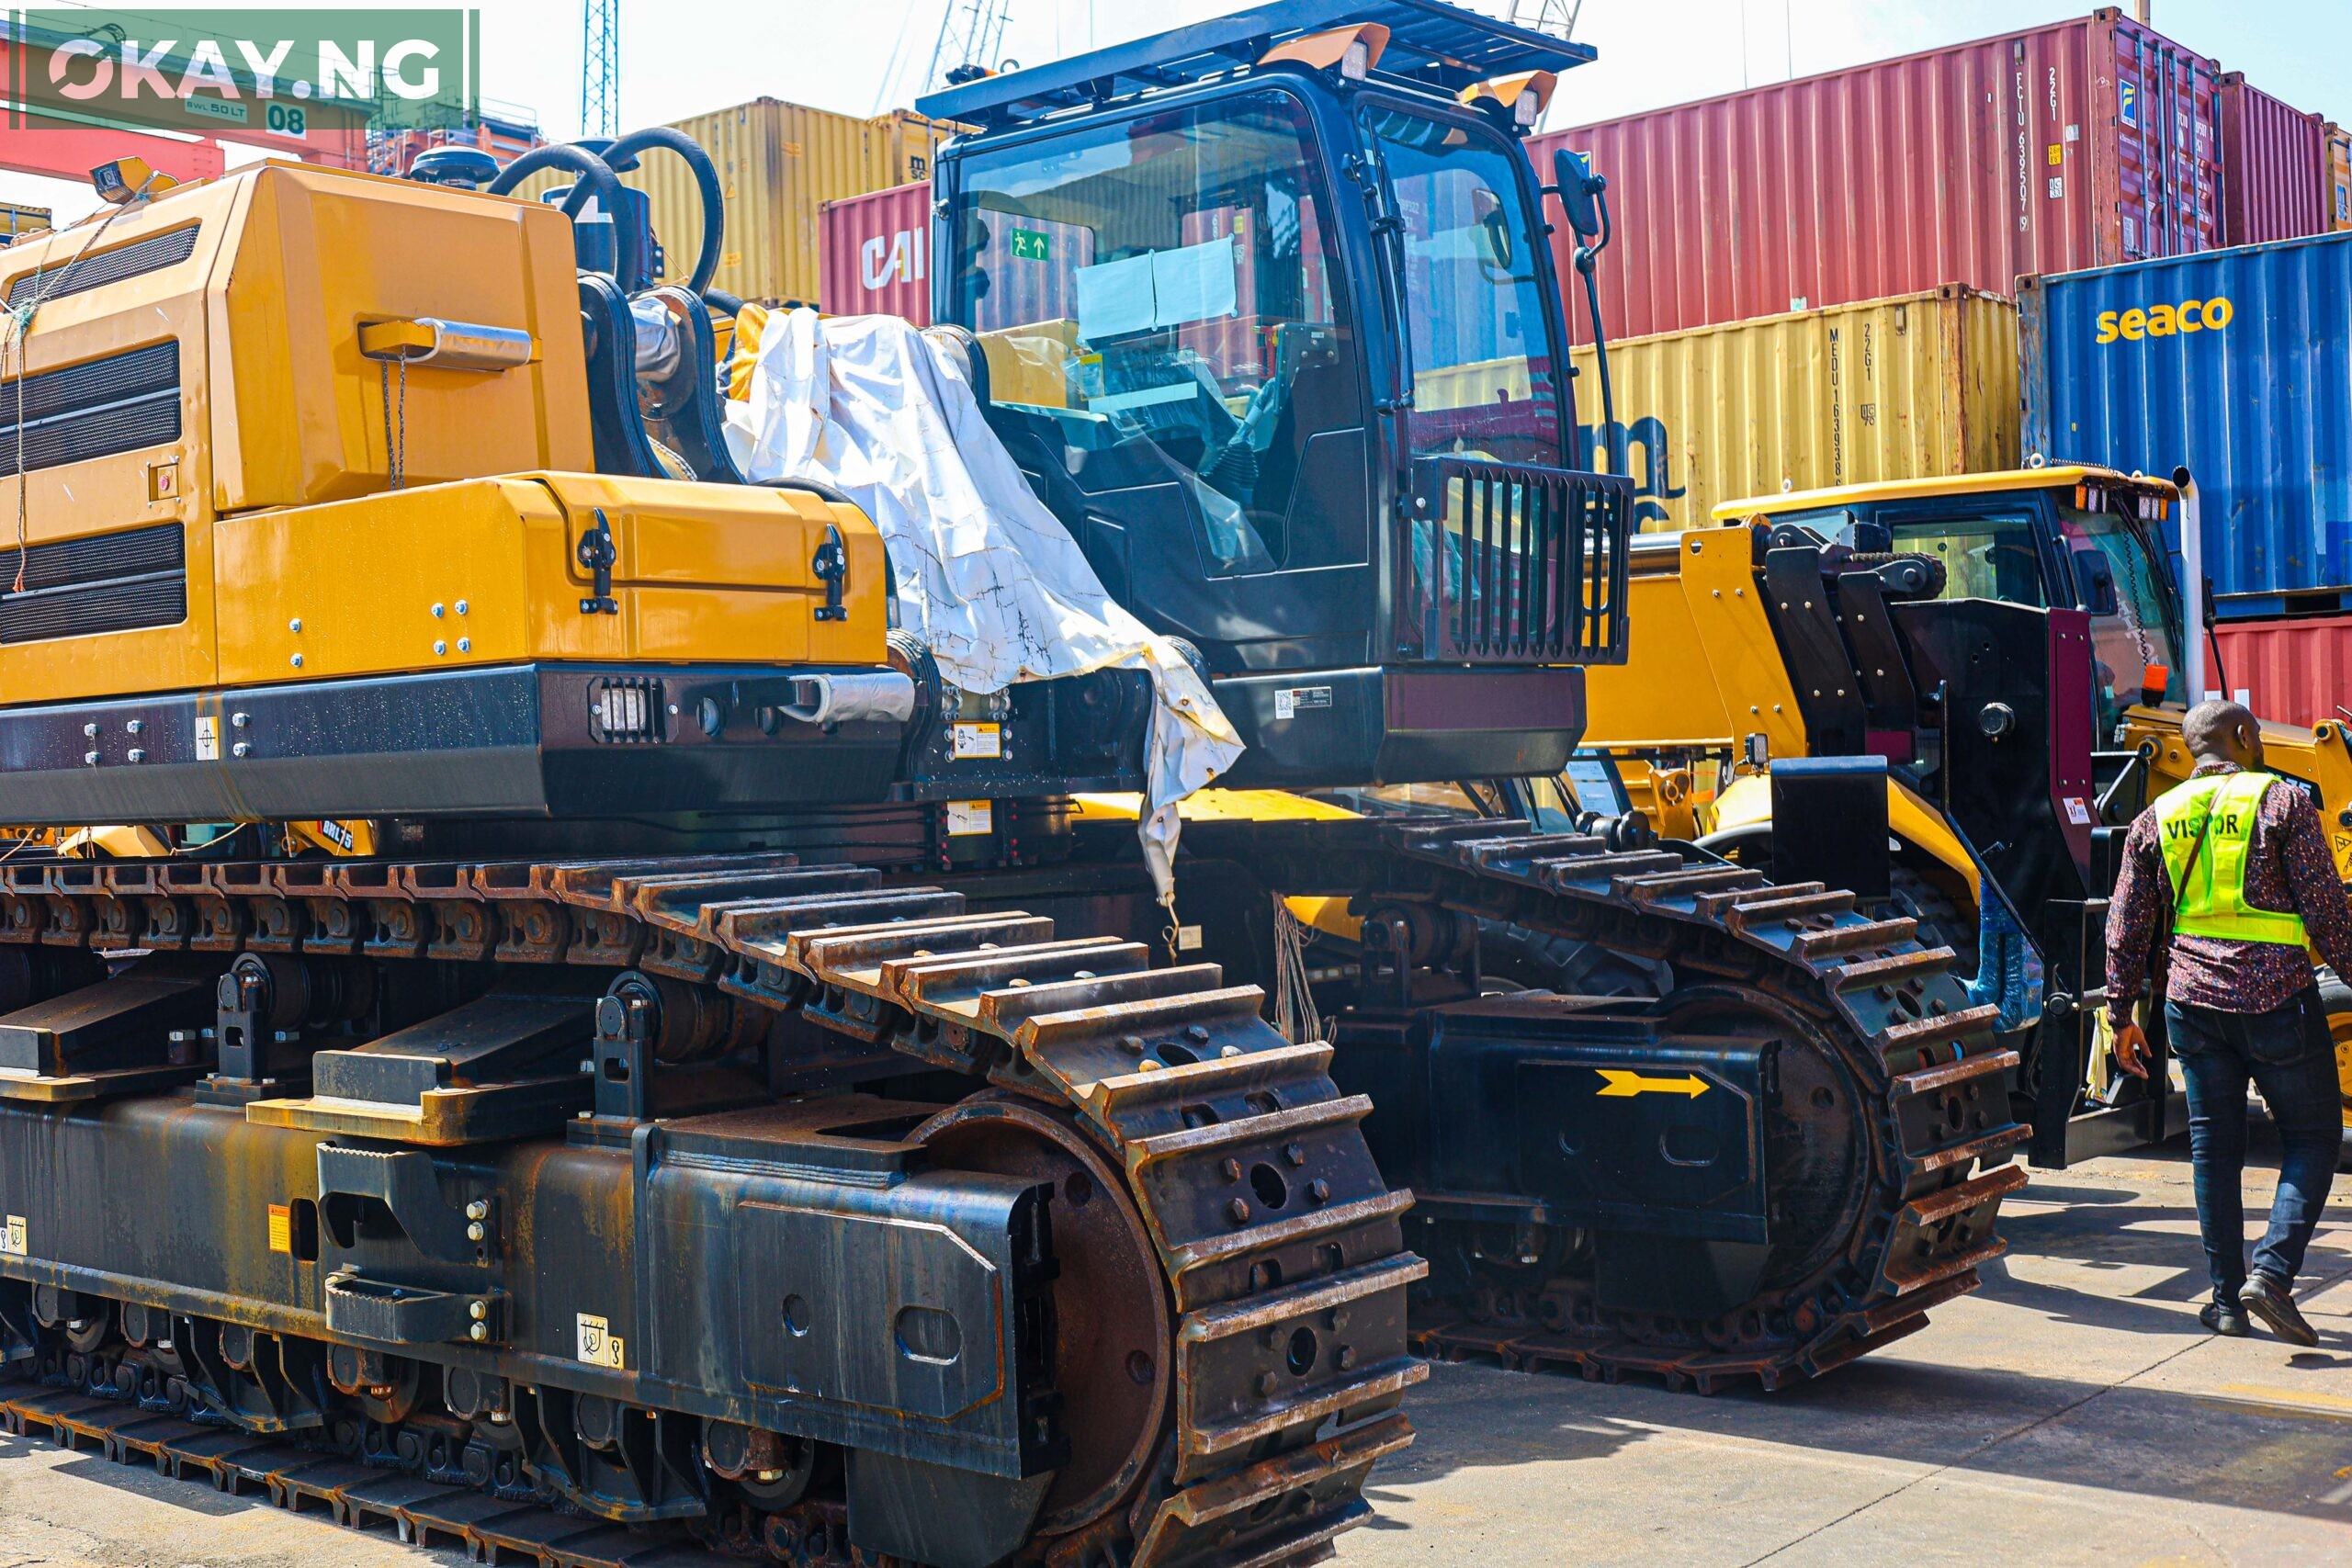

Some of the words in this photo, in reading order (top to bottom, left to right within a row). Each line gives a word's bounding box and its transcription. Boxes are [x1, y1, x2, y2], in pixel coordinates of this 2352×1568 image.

[187, 101, 208, 110] SWL
[268, 105, 305, 135] 08
[2016, 73, 2025, 127] FCIU
[2018, 131, 2027, 211] 639507
[862, 227, 924, 290] CAI
[2096, 297, 2233, 344] seaco
[1833, 389, 1841, 476] 163938
[2166, 814, 2238, 840] VISOR
